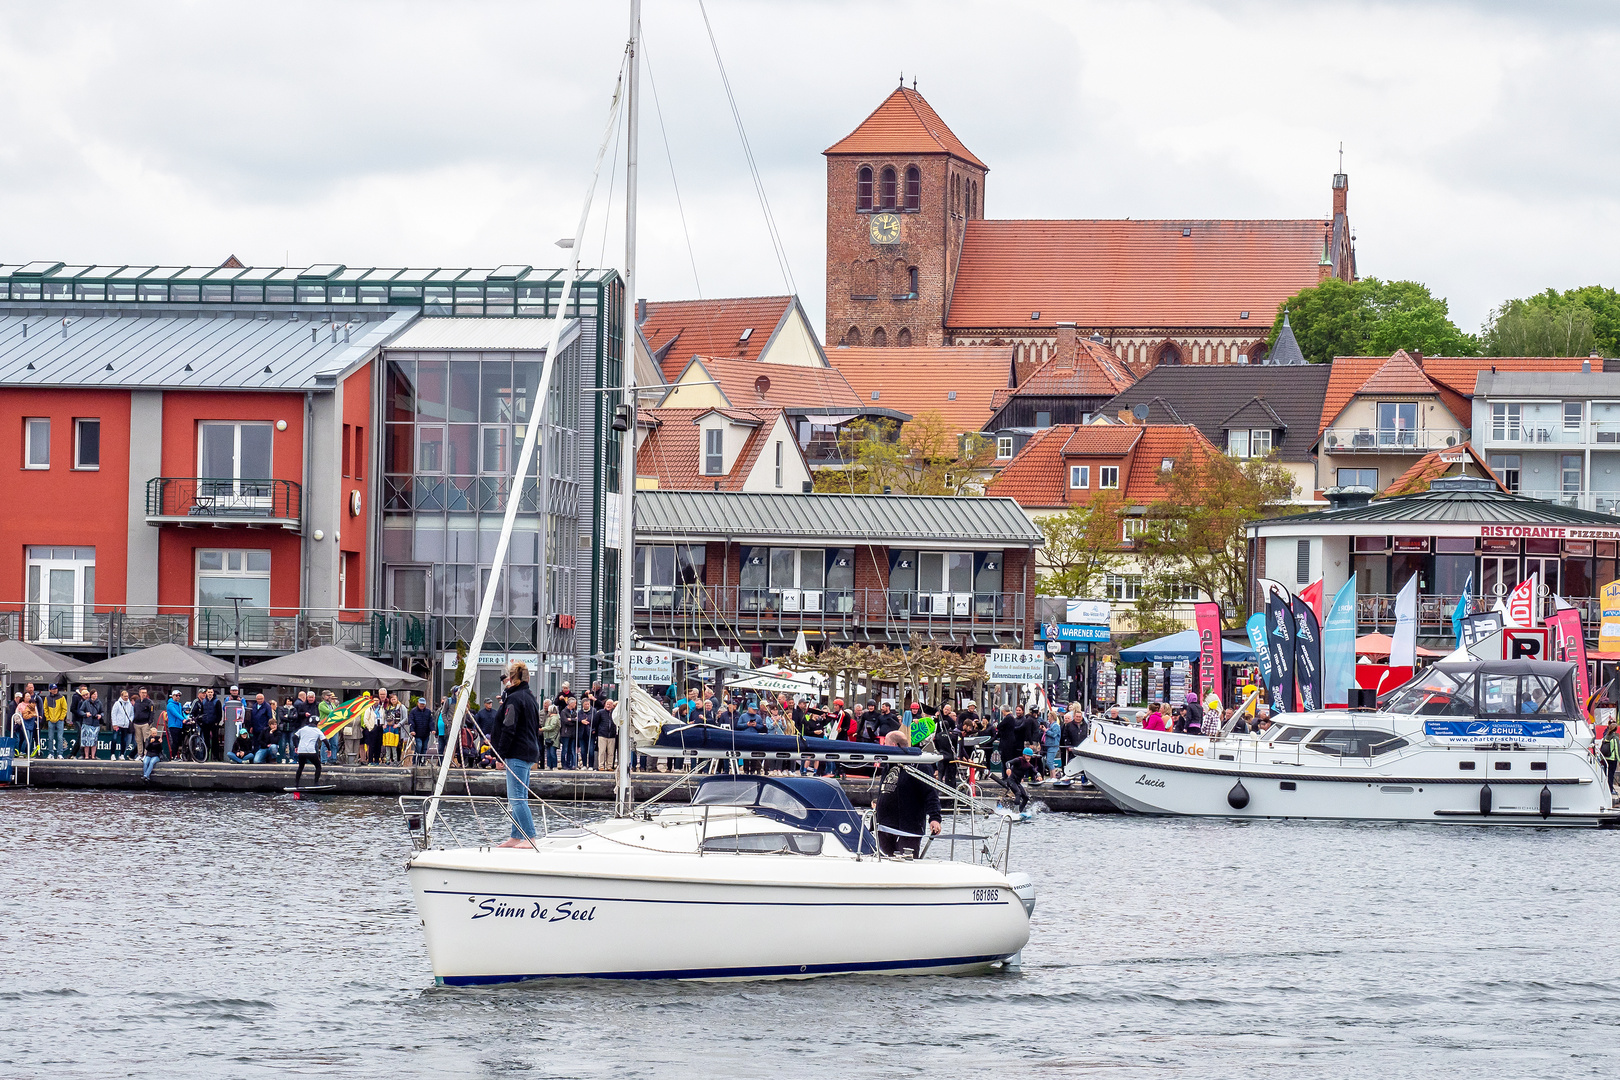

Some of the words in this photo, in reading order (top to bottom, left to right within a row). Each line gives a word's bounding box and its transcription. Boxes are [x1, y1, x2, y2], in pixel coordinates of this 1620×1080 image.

[1481, 526, 1566, 538] RISTORANTE
[1570, 530, 1620, 539] PIZZERIA
[1062, 627, 1094, 637] WARENER
[654, 655, 660, 665] 3
[993, 652, 1018, 663] PIER
[1028, 653, 1033, 663] 3
[1491, 727, 1523, 735] SCHULZ
[1108, 732, 1204, 757] Bootsurlaub.de
[1135, 774, 1166, 788] Lucia
[1013, 882, 1032, 890] HONDA
[972, 889, 999, 901] 168186S
[471, 898, 525, 919] Sünn
[530, 902, 548, 919] de
[548, 901, 597, 923] Seel
